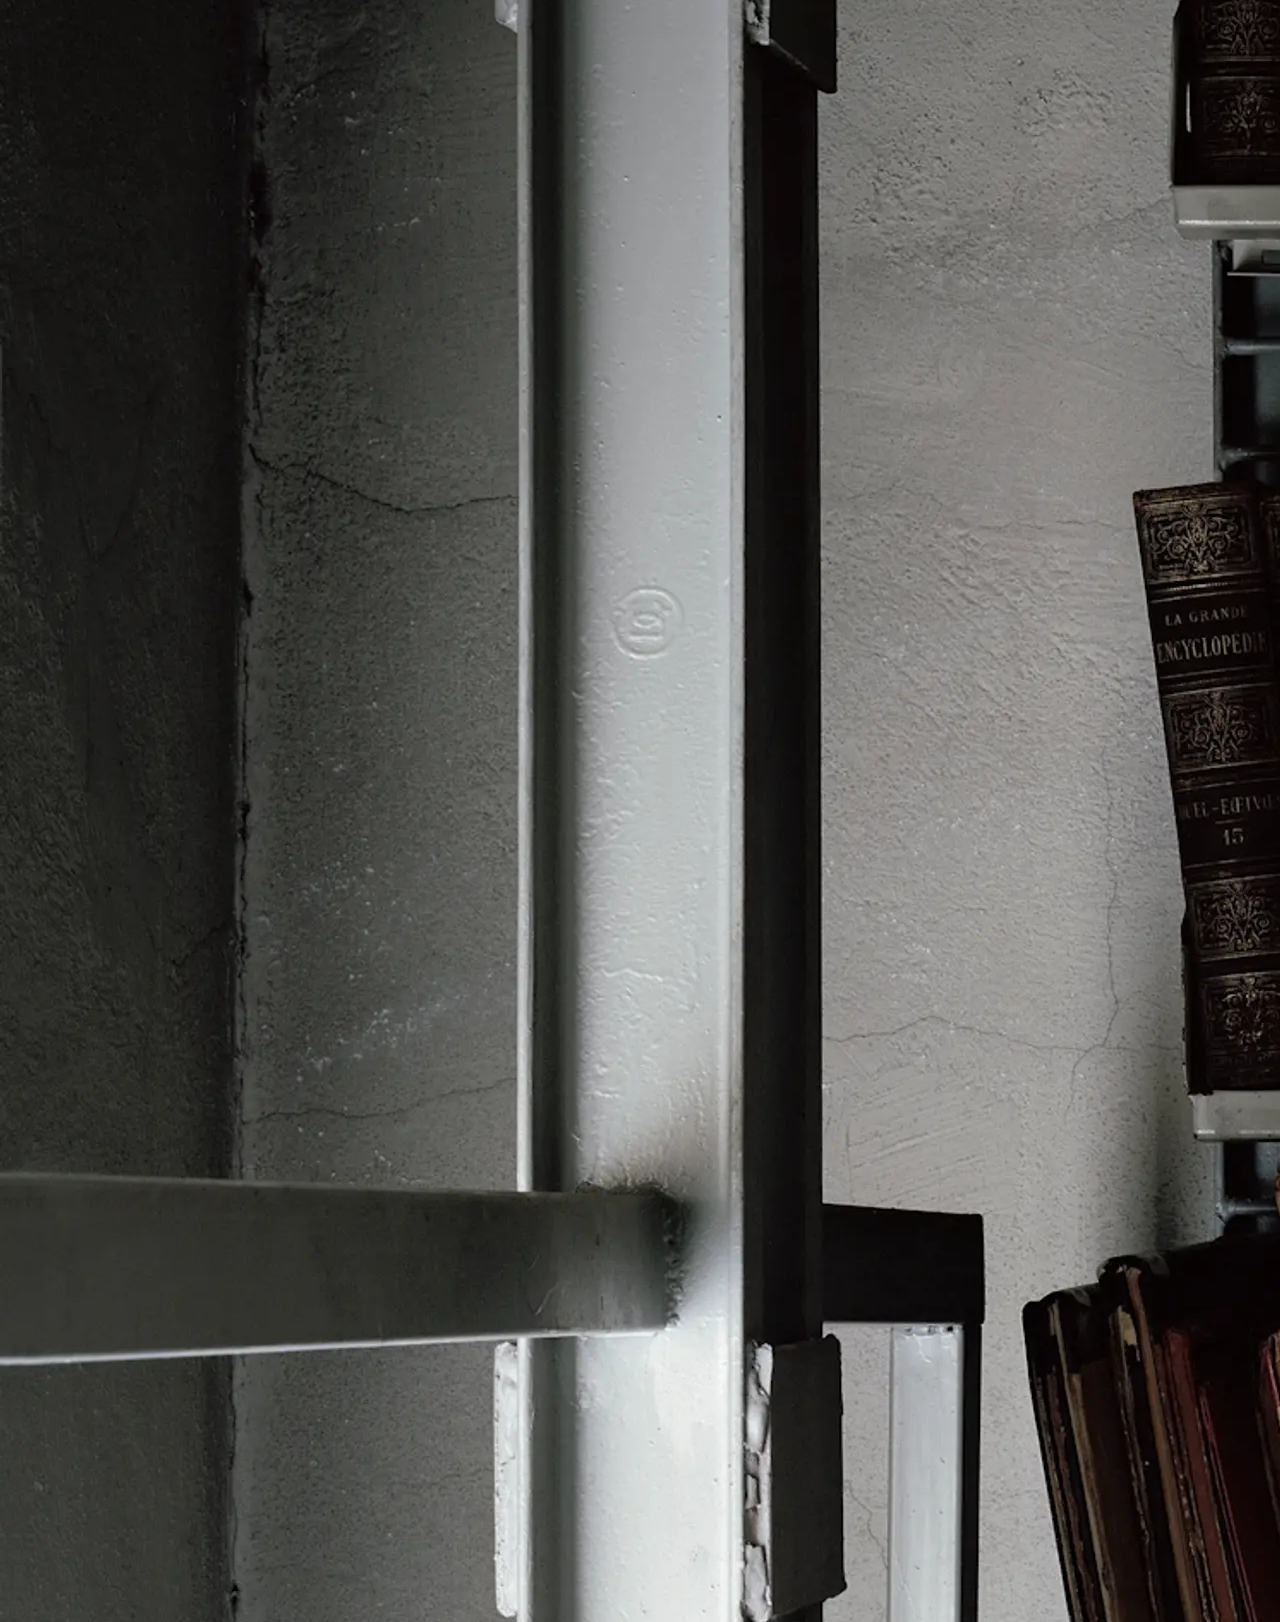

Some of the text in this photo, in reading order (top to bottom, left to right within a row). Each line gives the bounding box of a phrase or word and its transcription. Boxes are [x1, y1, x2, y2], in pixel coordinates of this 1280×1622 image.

[1164, 605, 1249, 627] LA GRANDE
[1222, 828, 1244, 846] 15
